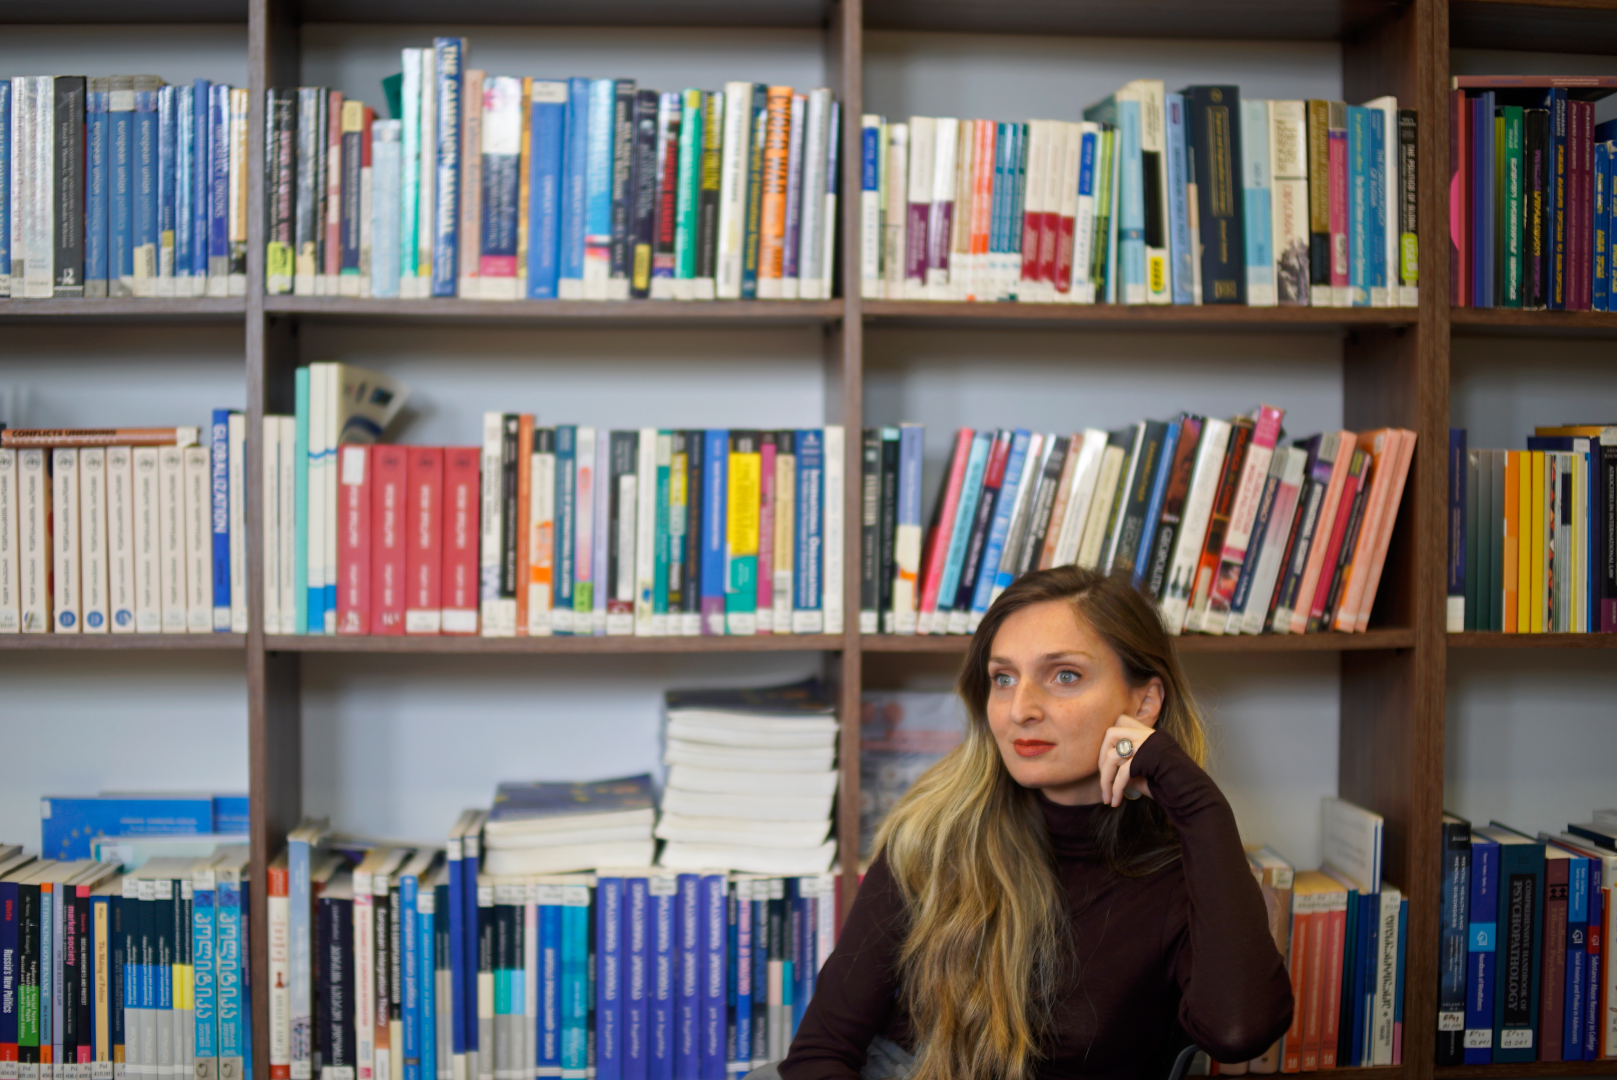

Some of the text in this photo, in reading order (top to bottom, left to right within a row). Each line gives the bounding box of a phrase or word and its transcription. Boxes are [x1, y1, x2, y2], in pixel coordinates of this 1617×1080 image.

[92, 121, 102, 164] european
[116, 121, 126, 164] european
[139, 121, 151, 164] european
[439, 45, 457, 237] THE CAMPAIGN MANUAL
[763, 95, 792, 194] CYBER WAR
[1276, 119, 1289, 172] KISSINGER
[1286, 127, 1298, 164] HENRY
[93, 167, 102, 194] union
[117, 167, 126, 194] union
[140, 167, 151, 194] union
[752, 172, 761, 182] of
[1407, 144, 1416, 232] THE POLITICS OF GLOBAL
[214, 179, 226, 218] UNIONS
[660, 193, 675, 242] MANAGER
[749, 183, 761, 232] International
[1282, 184, 1295, 246] DIPLOMACY
[746, 234, 758, 270] Terrorism
[11, 429, 63, 438] CONFLICTS
[212, 424, 228, 533] GLOBALIZATION
[808, 470, 820, 534] INTERNATIONAL
[1260, 477, 1278, 523] DIPLOMACY
[1293, 481, 1324, 575] INTERNATIONAL SECURITY
[562, 560, 570, 598] RELATIONS
[392, 893, 400, 922] ADAPTING
[66, 905, 76, 965] market society
[392, 932, 400, 964] EUROPEAN
[406, 909, 414, 950] european
[1508, 880, 1523, 1011] PSYCHOPATHOLOGY
[1520, 878, 1532, 1011] COMPREHENSIVE HANDBOOK OF
[1556, 907, 1565, 965] Handbook of
[42, 945, 50, 998] GOVERNANCE
[56, 950, 62, 958] ON
[96, 951, 105, 971] Making
[195, 913, 212, 1019] პოლიტიკა
[220, 913, 238, 1019] პოლიტიკა
[376, 908, 387, 1027] European Integration Theory
[1478, 953, 1486, 976] Handbook
[1590, 955, 1599, 982] Substance
[2, 949, 14, 1013] Russia's New Politics
[56, 987, 62, 995] OF
[98, 972, 106, 981] of
[392, 965, 400, 1004] INTEGRATION
[406, 977, 415, 1009] politics
[1547, 950, 1556, 1011] Psychotherapy
[1574, 966, 1582, 984] Anxiety
[1590, 983, 1598, 999] Abuse
[1476, 983, 1485, 1011] Mindfulness
[1588, 1000, 1597, 1024] Recovery
[1572, 1016, 1580, 1044] Adolescents
[1587, 1031, 1596, 1051] College
